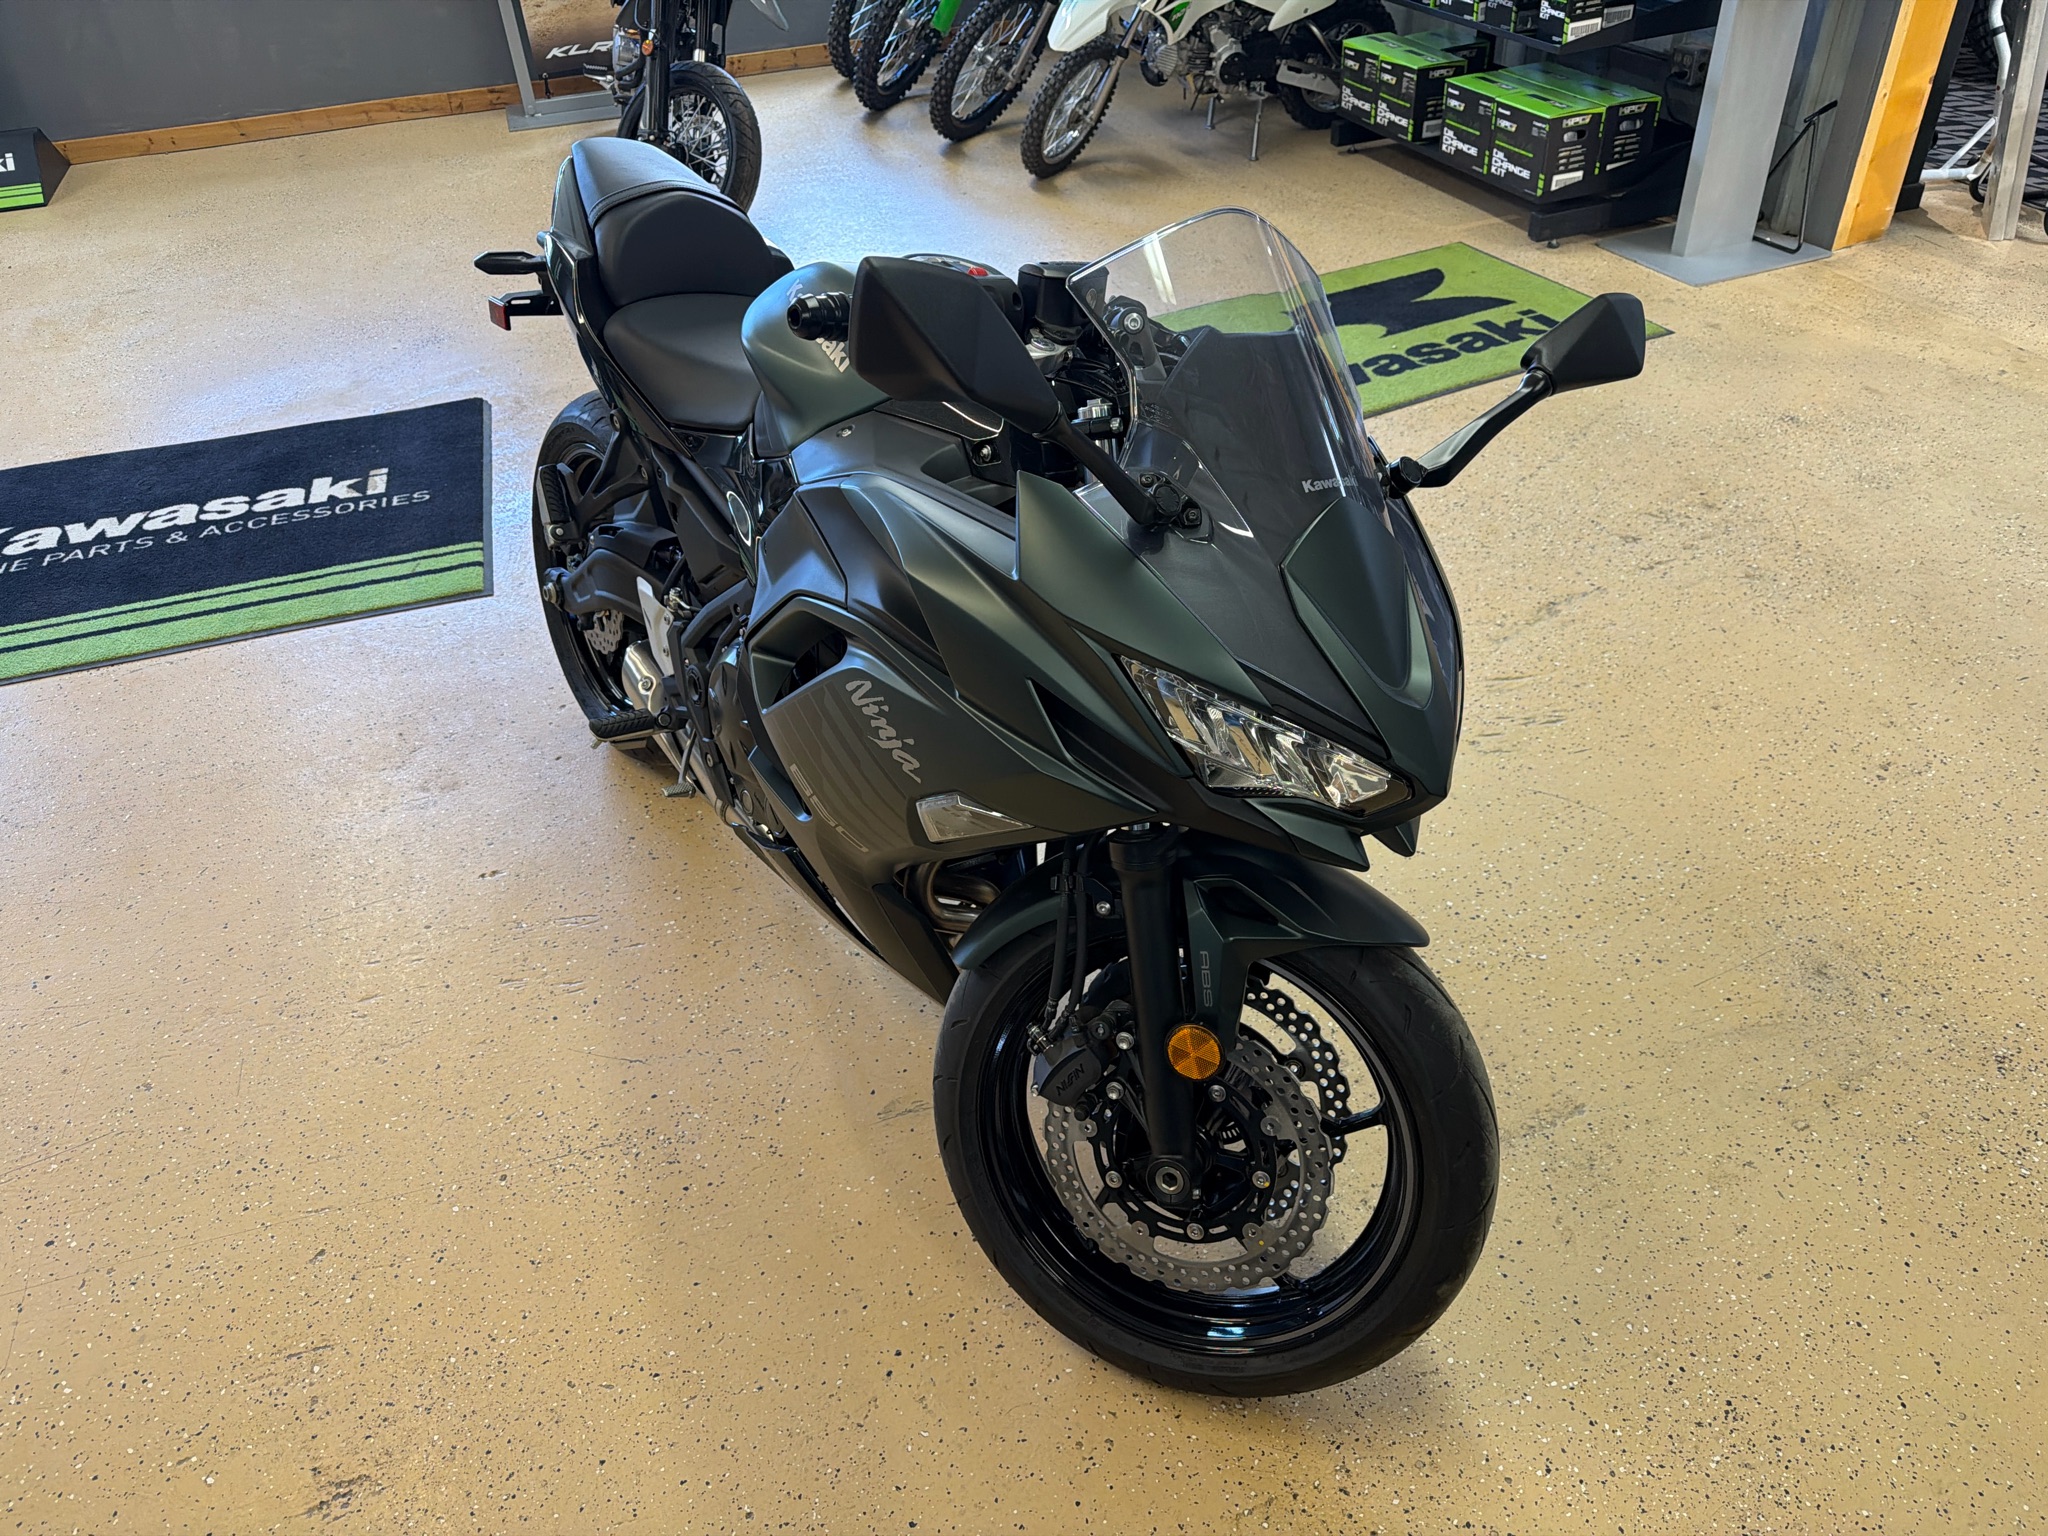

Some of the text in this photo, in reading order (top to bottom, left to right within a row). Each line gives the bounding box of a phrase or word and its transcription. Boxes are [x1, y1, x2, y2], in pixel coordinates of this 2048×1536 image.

[545, 40, 614, 60] KLR
[1341, 92, 1372, 112] CHANGE
[1341, 101, 1353, 111] KIT
[1376, 108, 1409, 128] CHANGE
[1376, 116, 1389, 127] KIT
[1441, 144, 1456, 155] KIT
[1442, 135, 1479, 157] CHANGE
[1490, 165, 1507, 178] KIT
[1491, 157, 1531, 180] CHANGE
[0, 467, 389, 556] awasaki
[42, 533, 153, 567] PARTS
[165, 530, 189, 544] &
[199, 490, 431, 539] ACCESSORIES
[845, 680, 922, 784] Ninja
[1199, 950, 1214, 1008] ABS
